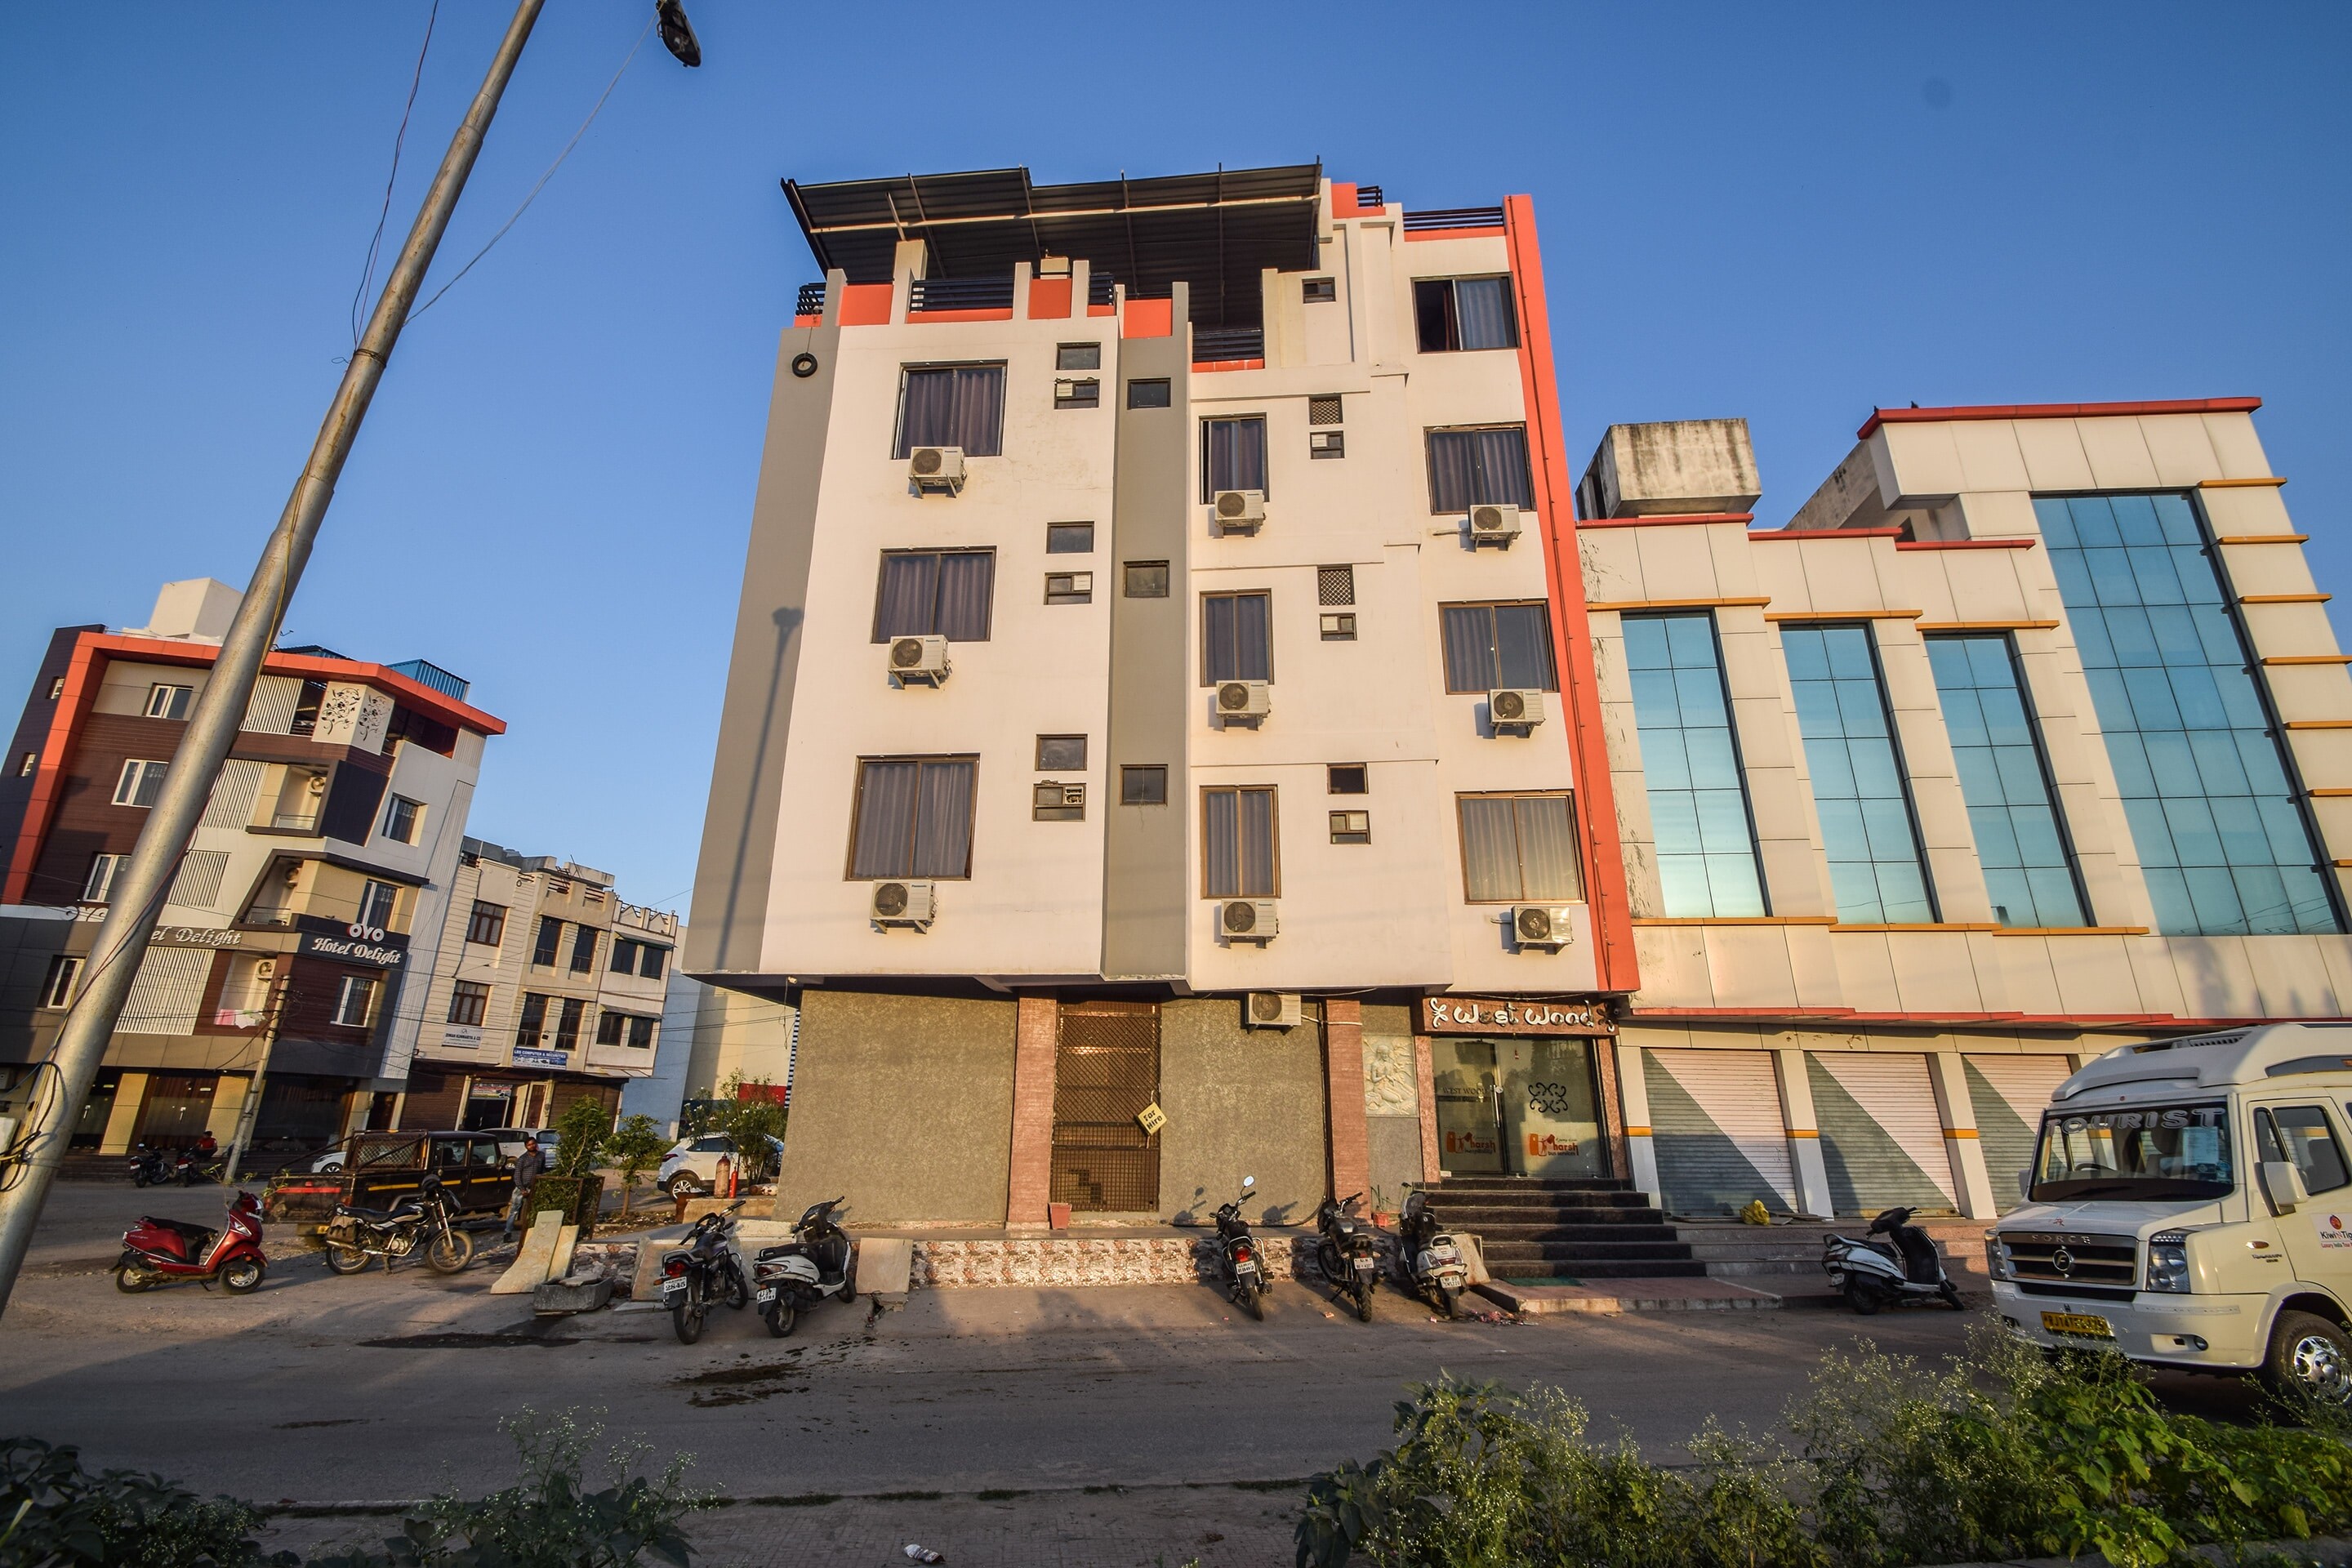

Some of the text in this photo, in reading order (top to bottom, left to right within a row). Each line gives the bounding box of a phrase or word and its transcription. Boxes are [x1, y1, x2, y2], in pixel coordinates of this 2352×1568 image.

[176, 928, 242, 946] Delight
[348, 923, 385, 942] OYO
[311, 938, 401, 964] Hotel Delight
[1143, 1109, 1156, 1121] For
[1147, 1115, 1163, 1130] Hire
[2046, 1107, 2226, 1138] TOURIST
[1470, 1139, 1496, 1153] harsh
[1553, 1142, 1579, 1156] harsh
[666, 1281, 686, 1290] 2845
